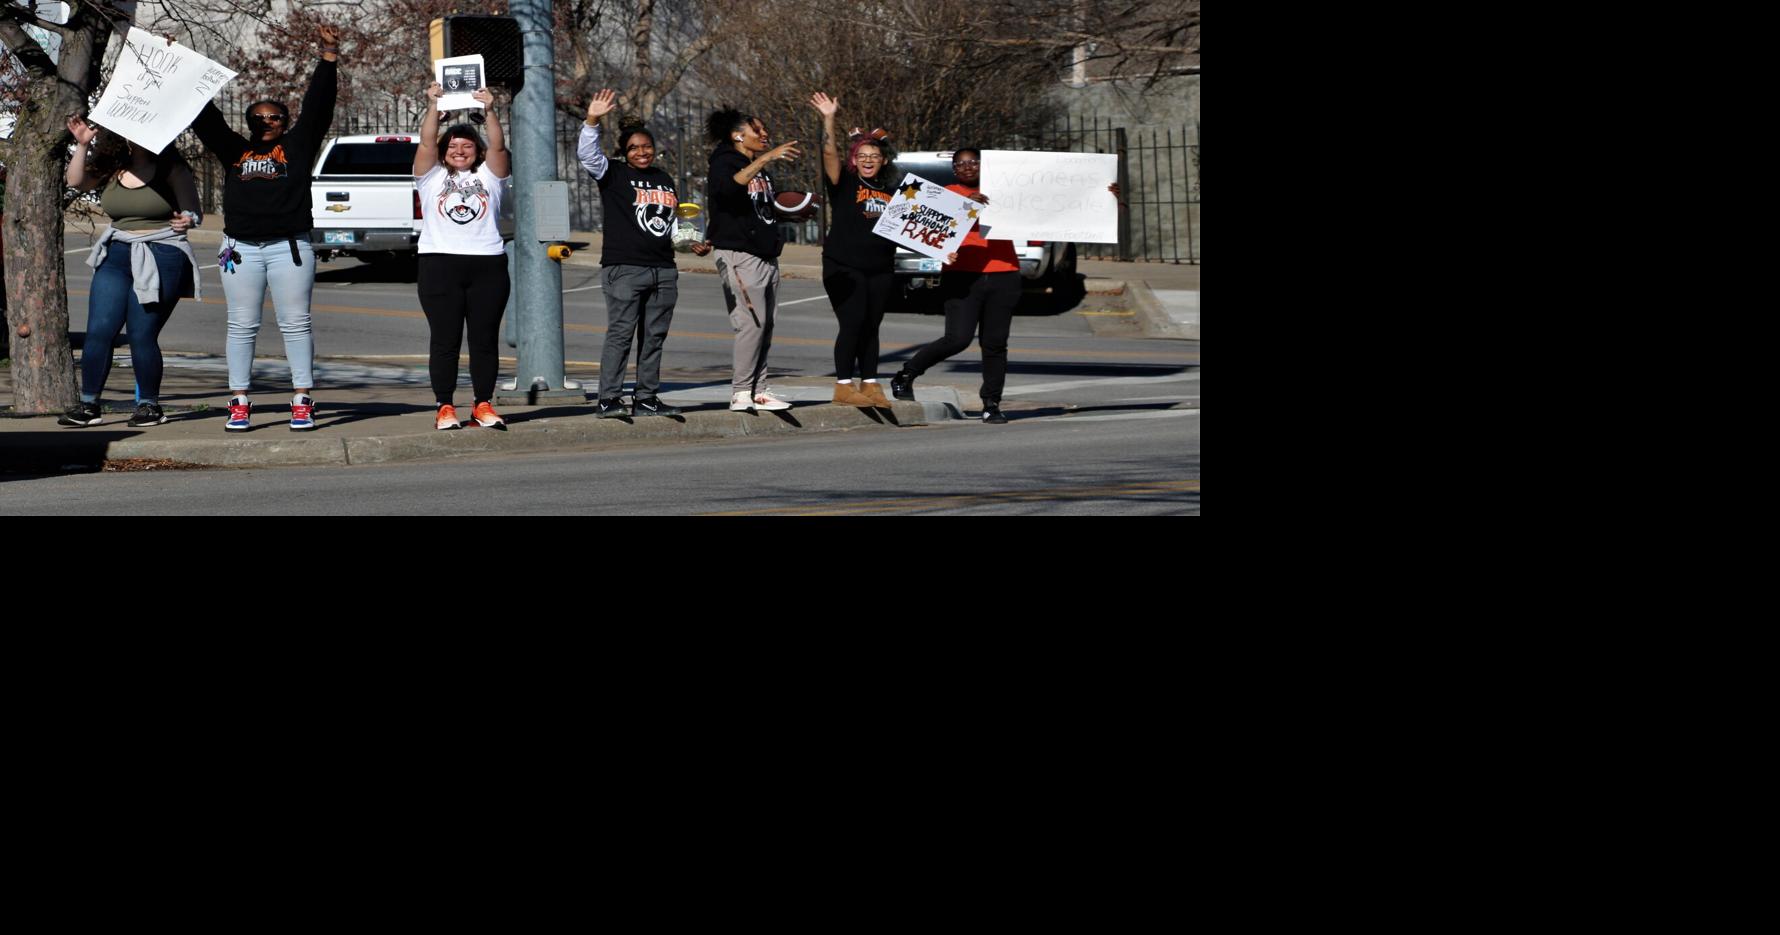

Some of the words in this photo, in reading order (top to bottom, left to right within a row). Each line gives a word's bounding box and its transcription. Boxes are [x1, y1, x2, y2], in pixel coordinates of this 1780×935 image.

[907, 210, 950, 233] OKLAHOMA
[919, 204, 954, 225] SUPPORT
[900, 221, 950, 249] RAGE
